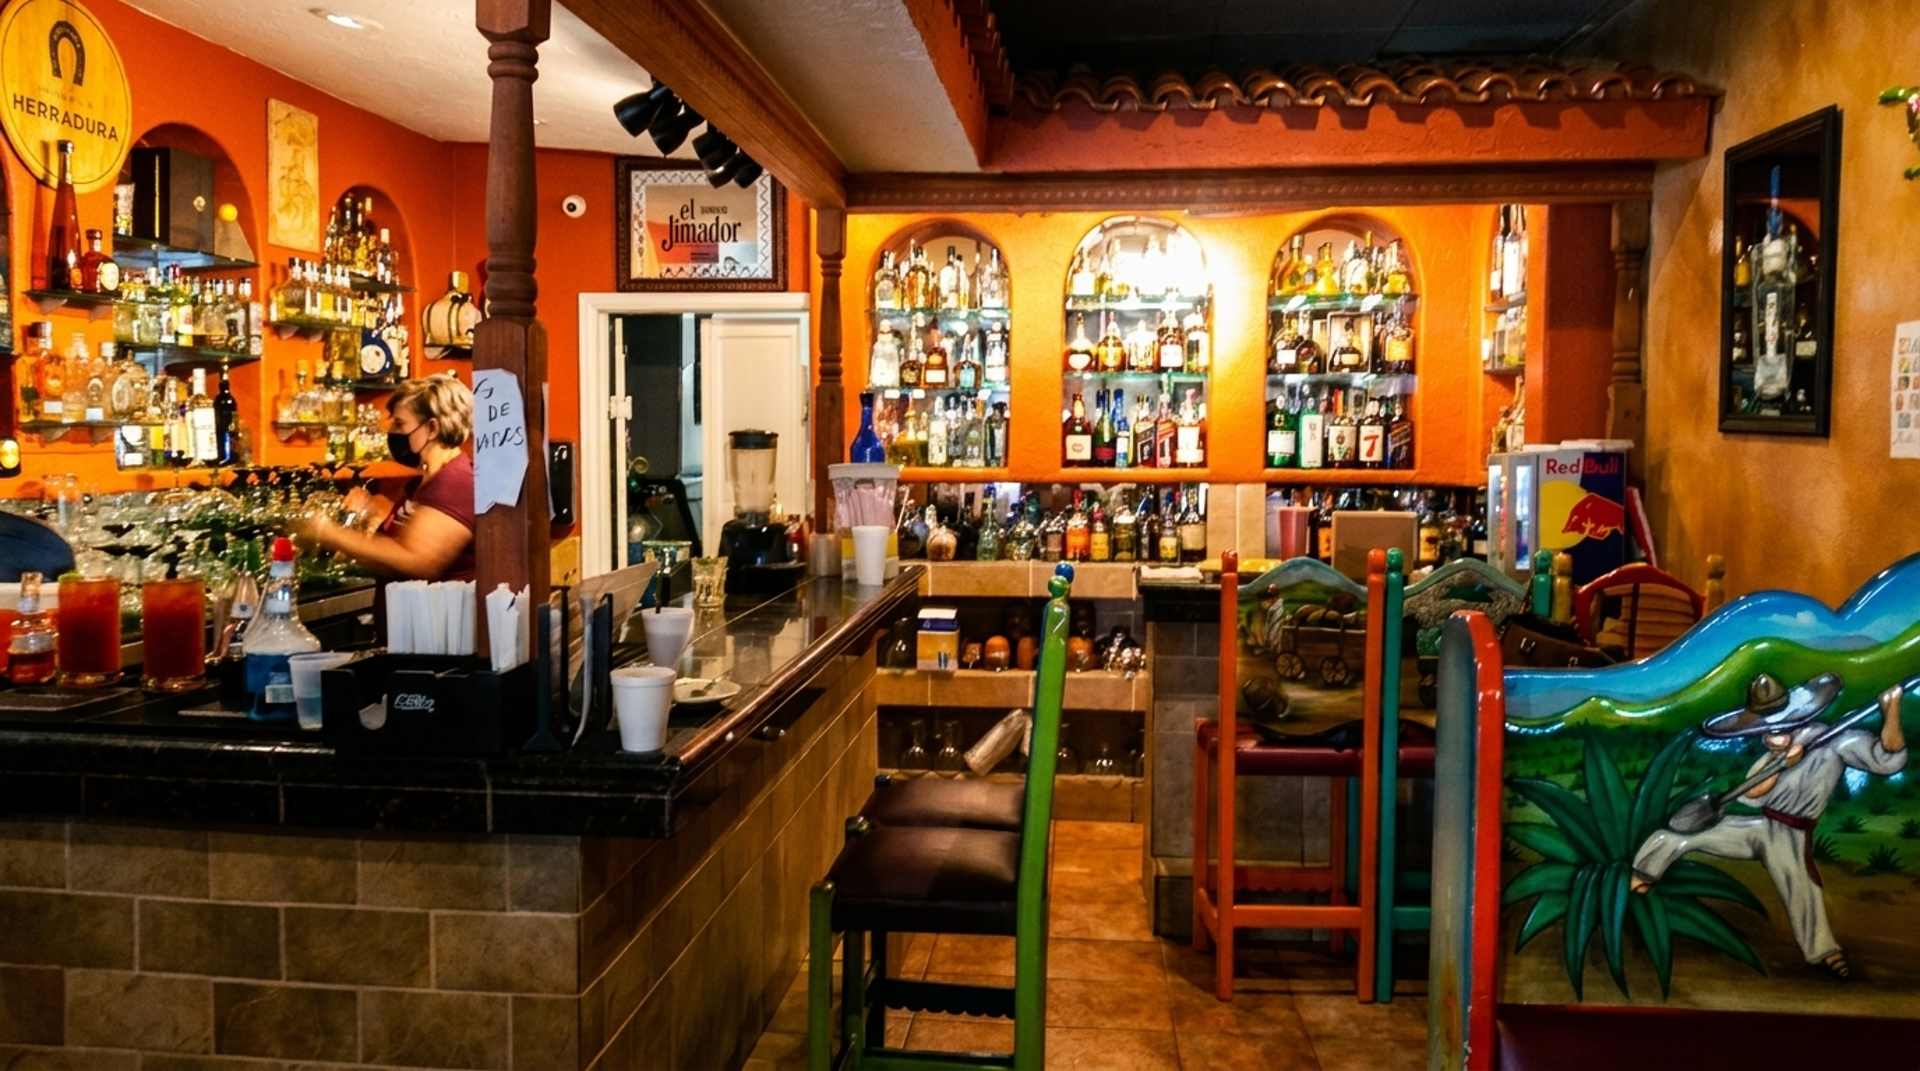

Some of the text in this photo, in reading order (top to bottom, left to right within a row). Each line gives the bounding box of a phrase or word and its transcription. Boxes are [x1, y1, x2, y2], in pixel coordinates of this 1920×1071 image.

[13, 93, 118, 142] HERRADURA
[680, 198, 695, 220] el
[661, 214, 742, 252] Jimador
[488, 402, 510, 423] DE
[1545, 456, 1618, 475] Red Bull
